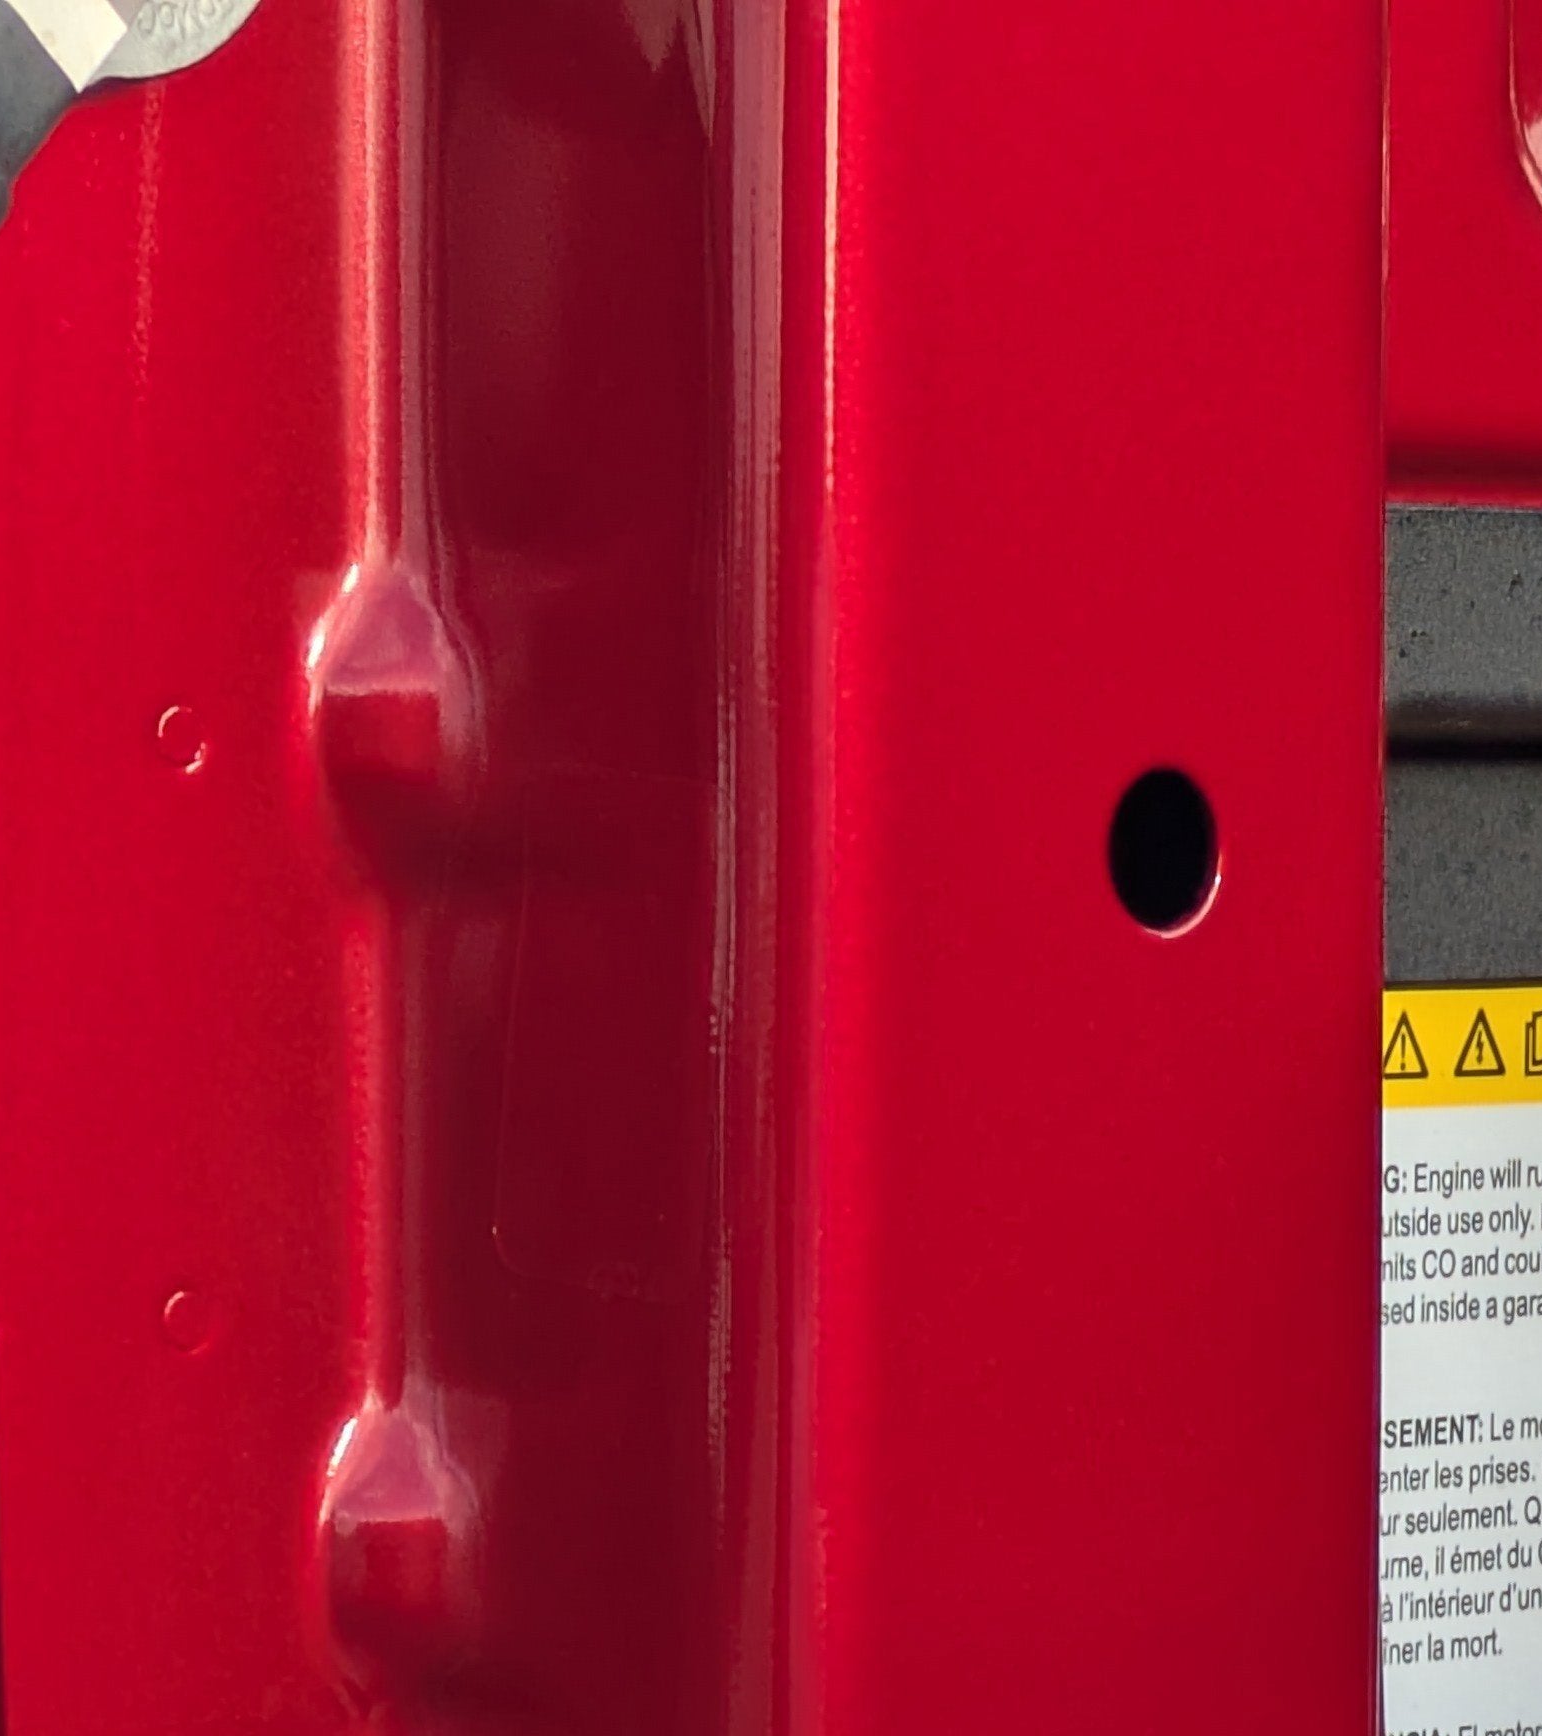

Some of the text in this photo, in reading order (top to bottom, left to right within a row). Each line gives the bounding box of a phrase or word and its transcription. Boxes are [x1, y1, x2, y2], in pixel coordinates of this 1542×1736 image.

[1414, 1162, 1485, 1199] Engine
[1490, 1158, 1522, 1189] will
[1447, 1211, 1483, 1235] use
[1489, 1203, 1535, 1238] only.
[1422, 1248, 1456, 1279] CO
[1462, 1247, 1499, 1277] and
[1421, 1292, 1480, 1323] inside
[1486, 1297, 1498, 1319] a
[1490, 1413, 1515, 1442] Le
[1435, 1459, 1463, 1488] les
[1469, 1455, 1536, 1494] prises.
[1405, 1500, 1518, 1535] seulement.
[1436, 1546, 1444, 1575] il
[1451, 1543, 1502, 1575] émet
[1507, 1540, 1532, 1569] du
[1400, 1587, 1494, 1620] l'intérieur
[1499, 1582, 1542, 1611] d'un
[1427, 1633, 1444, 1661] la
[1451, 1628, 1502, 1659] mort.
